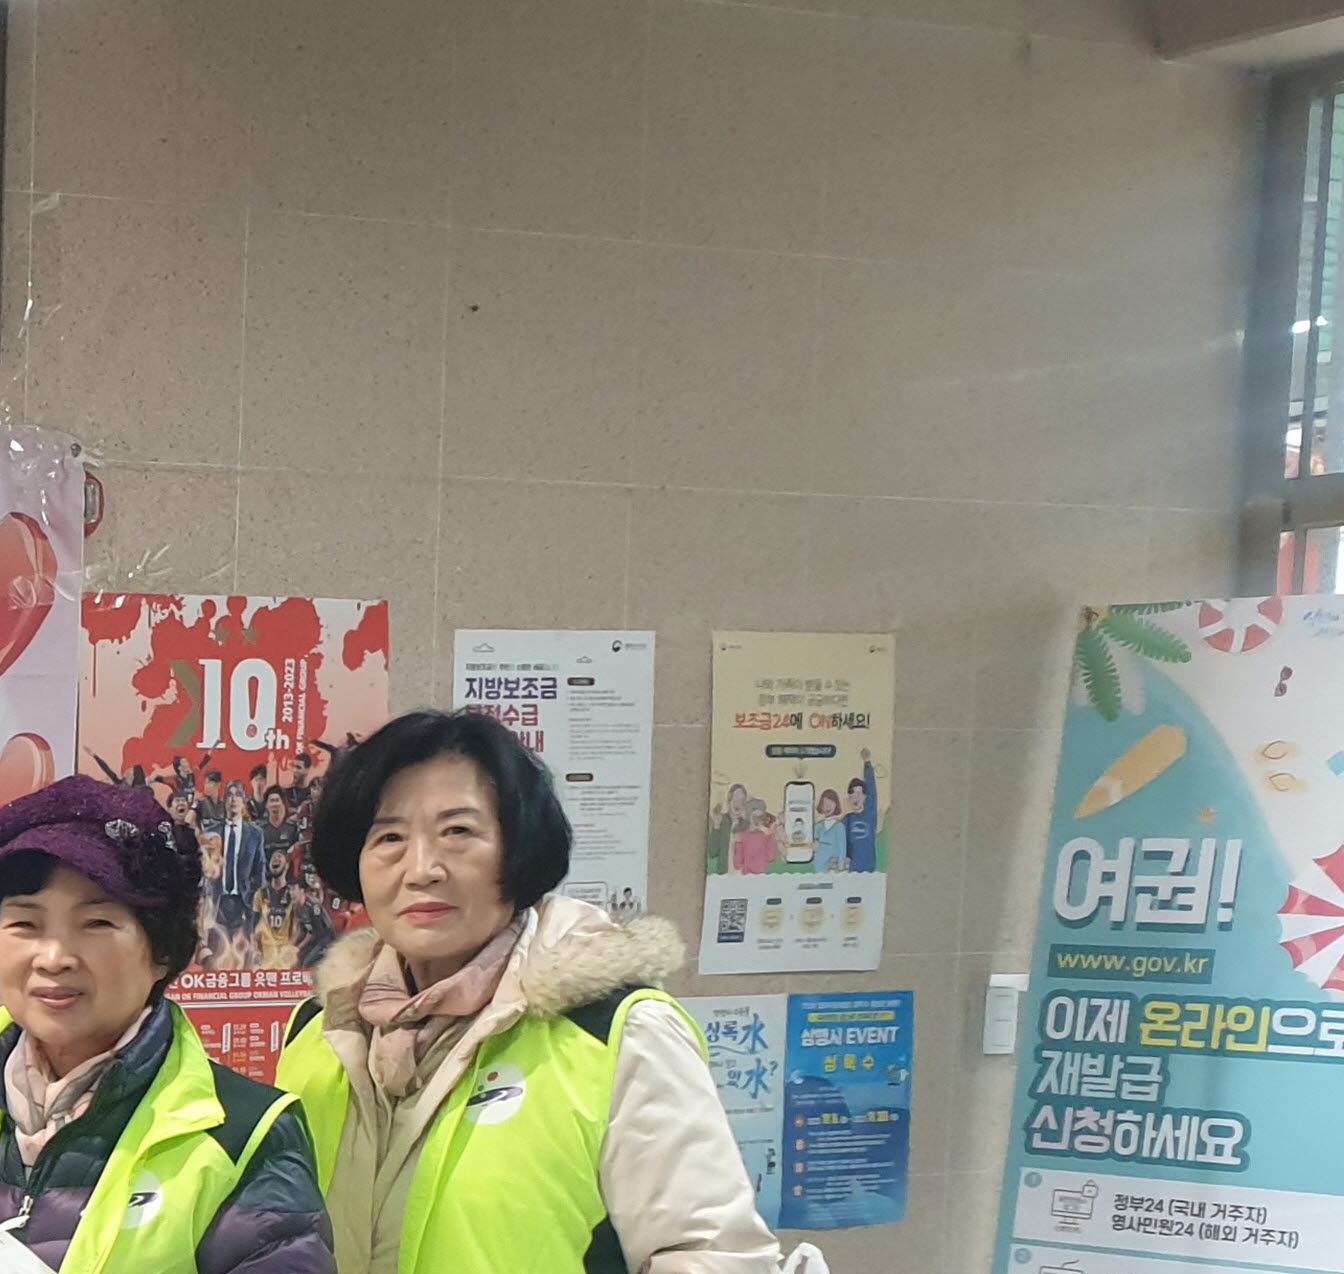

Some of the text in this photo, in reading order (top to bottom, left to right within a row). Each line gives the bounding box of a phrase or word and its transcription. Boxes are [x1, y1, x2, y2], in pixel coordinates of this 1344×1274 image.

[282, 658, 296, 723] 2013-2023
[464, 676, 558, 700] 지방보조금
[734, 711, 870, 731] 보조금24에 ON하세요!
[1052, 836, 1243, 931] 여권!
[1056, 952, 1209, 978] www.gov.kr
[845, 1026, 900, 1046] EVENT
[1045, 995, 1131, 1043] 이제
[1036, 1050, 1162, 1101] 재발급
[1031, 1104, 1245, 1166] 신청하세요
[1113, 1193, 1268, 1225] 정부24 (국내 거주자)
[1111, 1214, 1299, 1250] 영사민원24 (해외 거주자)
